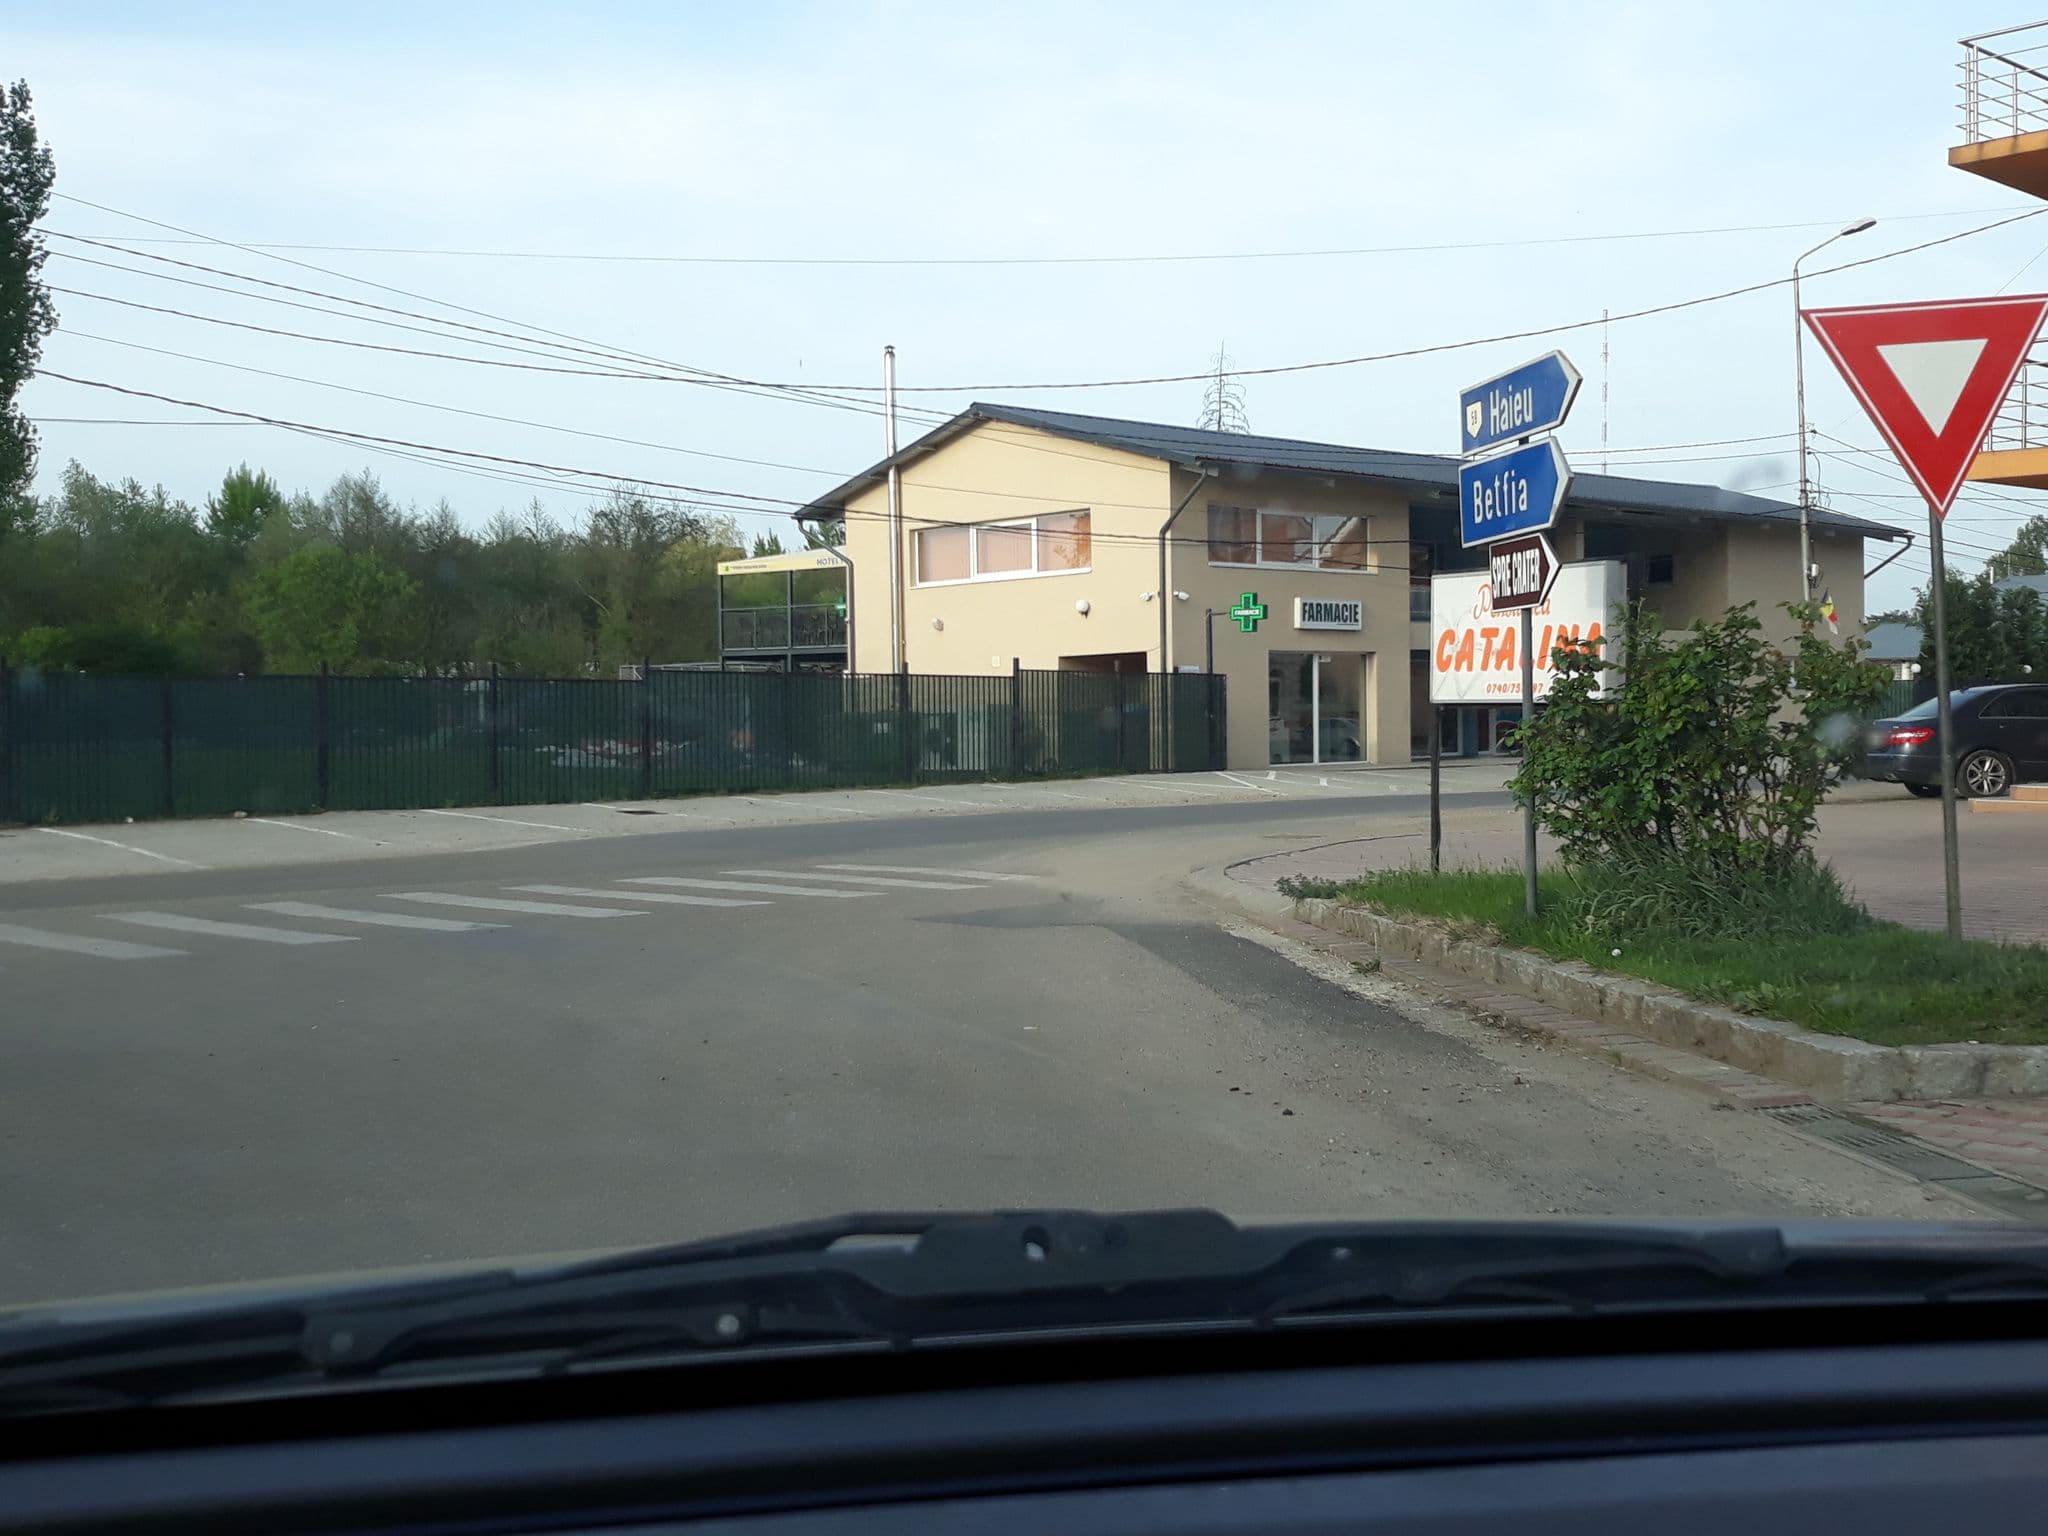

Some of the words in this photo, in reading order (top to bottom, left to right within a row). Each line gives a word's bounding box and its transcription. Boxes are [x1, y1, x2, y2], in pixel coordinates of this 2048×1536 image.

[1489, 384, 1533, 437] Haieu
[1473, 469, 1528, 525] Betfia
[1492, 554, 1511, 599] SPRE
[1512, 547, 1540, 597] CRATER
[1302, 602, 1360, 623] FARMACIE
[1436, 622, 1601, 673] CATAINA
